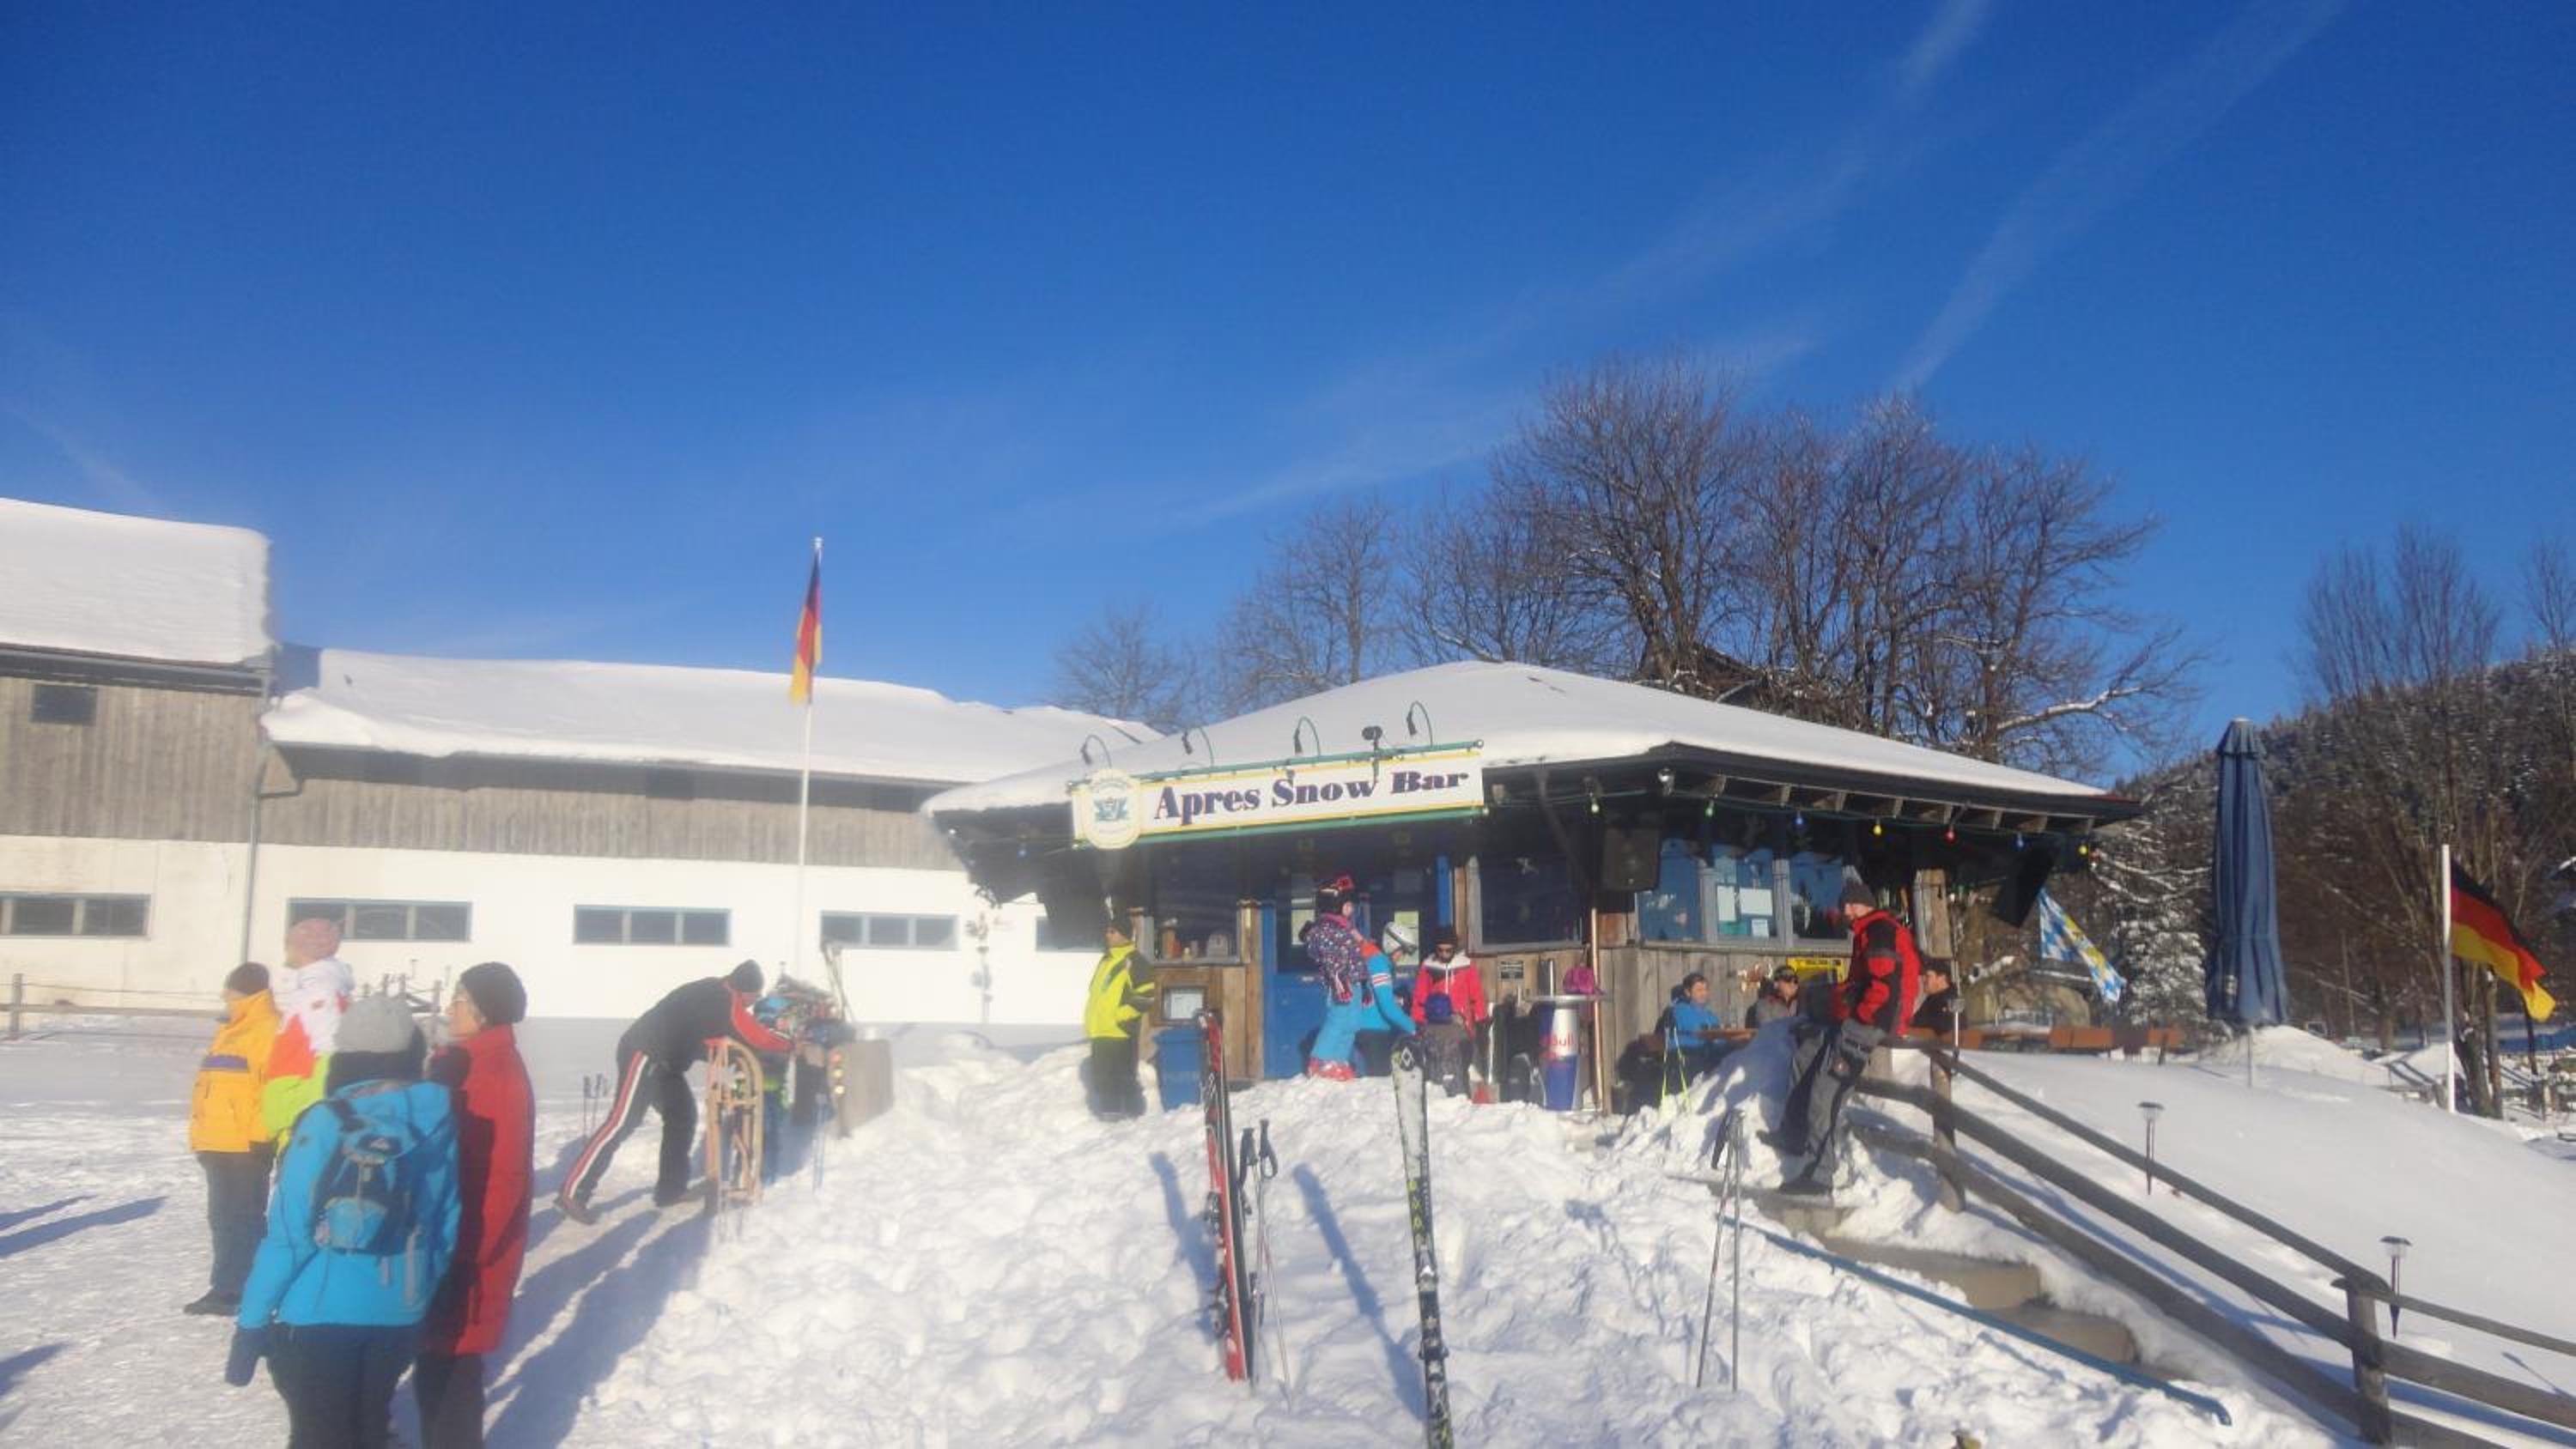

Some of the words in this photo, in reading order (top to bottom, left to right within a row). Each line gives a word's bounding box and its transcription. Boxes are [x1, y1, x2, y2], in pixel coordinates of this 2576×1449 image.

[1154, 785, 1261, 826] Apres
[1273, 779, 1378, 808] Snow
[1390, 771, 1469, 794] Bar
